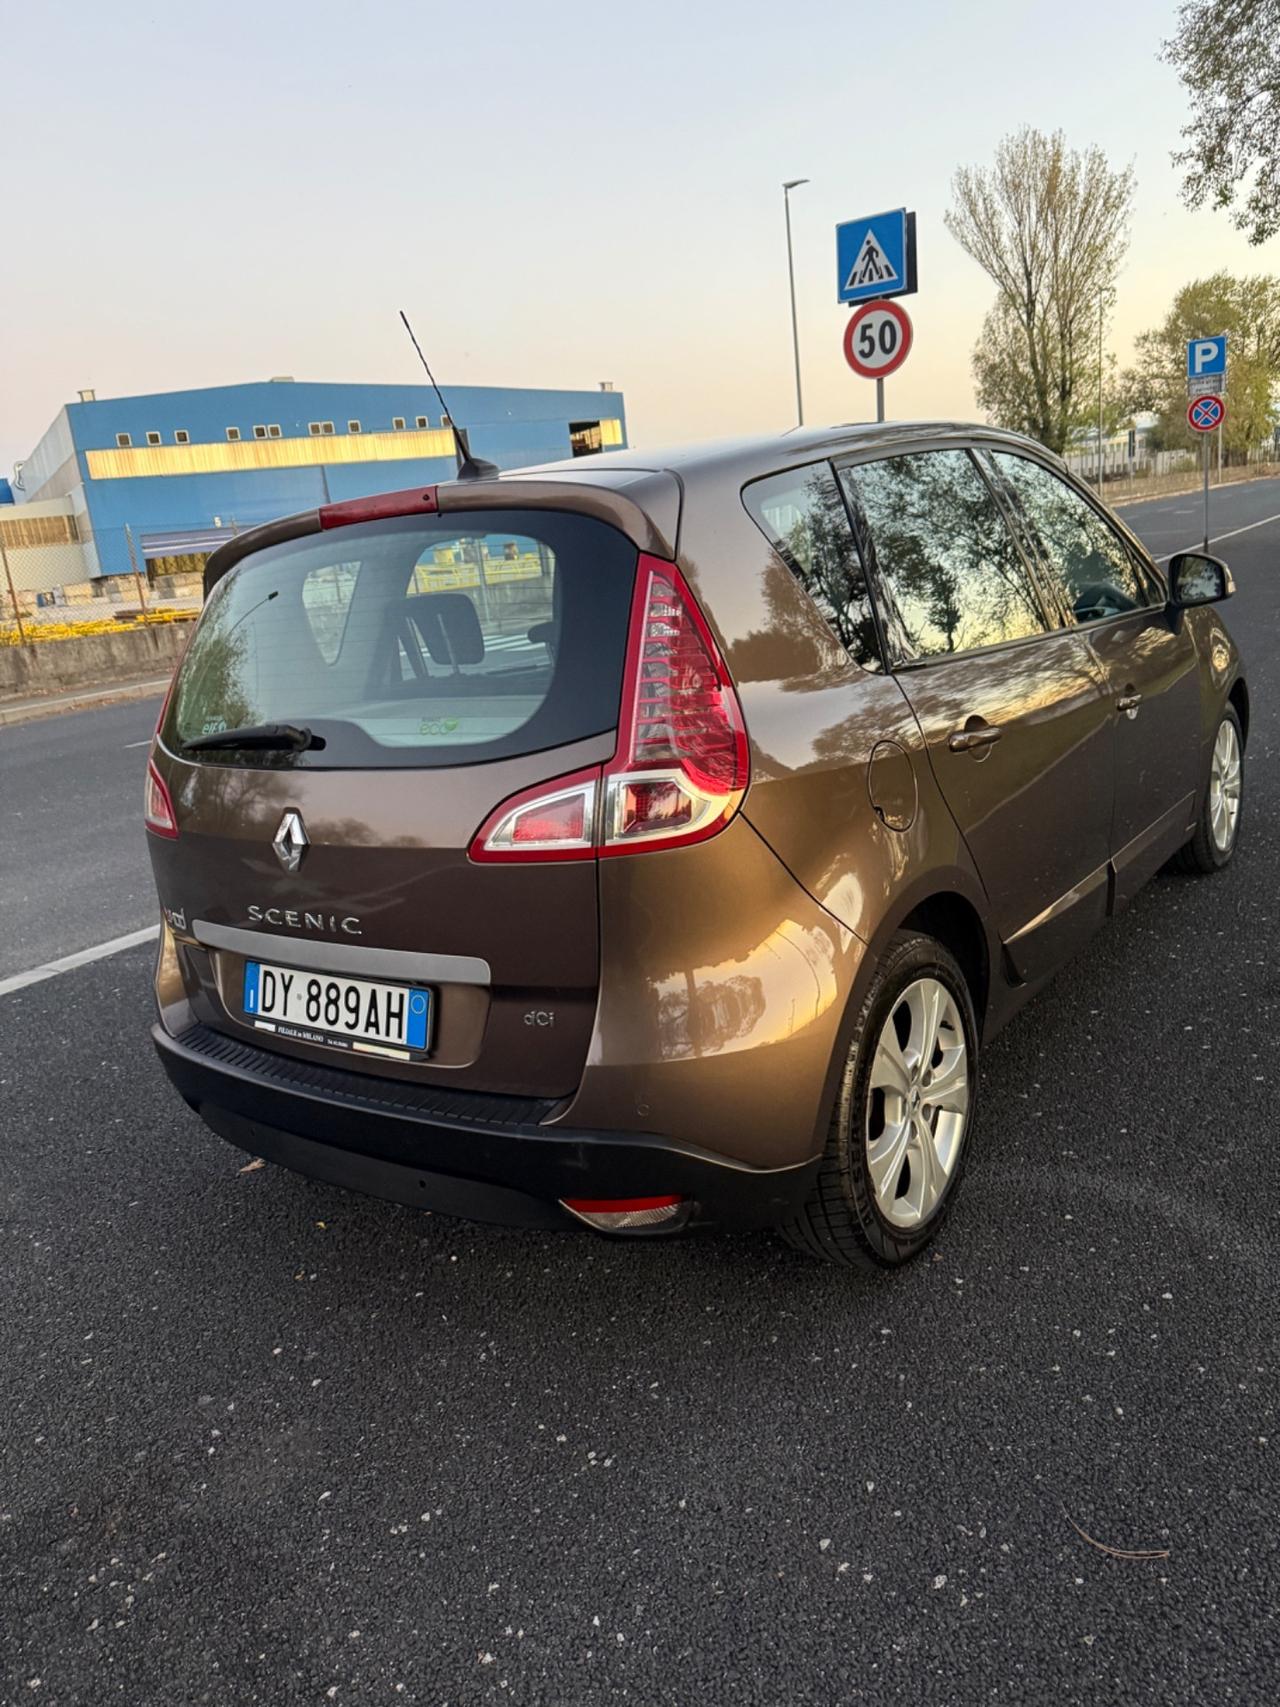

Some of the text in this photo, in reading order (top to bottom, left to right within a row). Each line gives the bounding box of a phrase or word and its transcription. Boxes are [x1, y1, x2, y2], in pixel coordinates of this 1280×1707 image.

[858, 319, 897, 359] 50
[1194, 341, 1219, 374] P
[247, 905, 362, 934] SCENIC
[261, 970, 405, 1040] DY 889AH
